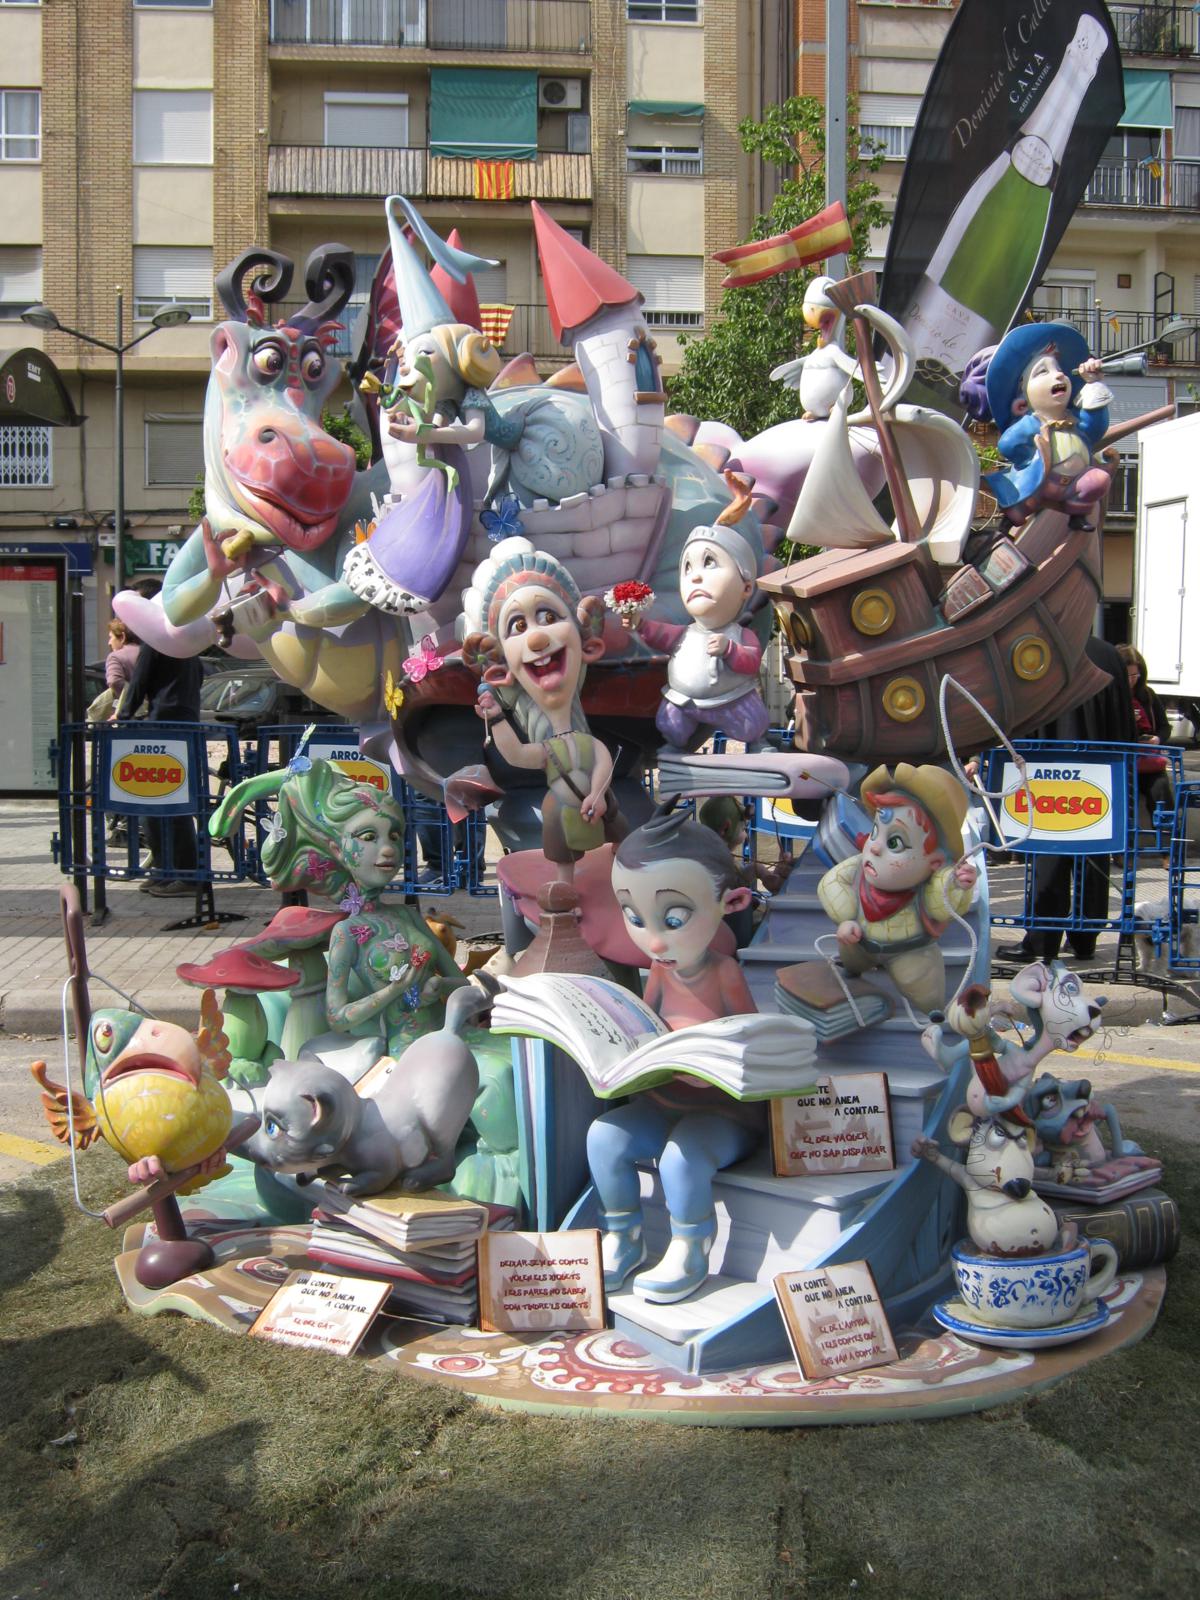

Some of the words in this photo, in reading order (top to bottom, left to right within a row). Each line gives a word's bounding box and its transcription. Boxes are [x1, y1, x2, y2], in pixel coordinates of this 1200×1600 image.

[1010, 53, 1044, 104] CAVA
[952, 70, 1004, 149] Dominio
[1002, 26, 1019, 72] de
[28, 362, 40, 376] EMT
[134, 744, 166, 754] ARROZ
[120, 762, 182, 783] Dacsa
[1034, 769, 1081, 780] ARROZ
[1015, 788, 1102, 815] Dacsa
[797, 1098, 816, 1106] QUE
[835, 1096, 860, 1104] ANEM
[835, 1108, 840, 1116] A
[803, 1136, 814, 1144] EL
[816, 1135, 832, 1144] DEL
[833, 1132, 868, 1143] VAQUER
[790, 1150, 807, 1159] QUE
[809, 1150, 821, 1159] NO
[823, 1149, 840, 1158] SAP
[842, 1145, 887, 1157] DISPARAR
[559, 1258, 588, 1266] CONTES
[534, 1273, 547, 1281] ELS
[311, 1280, 336, 1289] CONTE
[790, 1283, 802, 1293] UN
[803, 1278, 828, 1290] CONTE
[332, 1292, 355, 1301] ANEM
[805, 1292, 820, 1303] QUE
[822, 1290, 832, 1298] NO
[835, 1285, 855, 1297] ANEM
[838, 1300, 844, 1309] A
[829, 1324, 838, 1332] DE
[825, 1340, 837, 1349] ELS
[837, 1335, 863, 1347] CONTES
[864, 1331, 876, 1340] QUE
[835, 1354, 847, 1365] VAN
